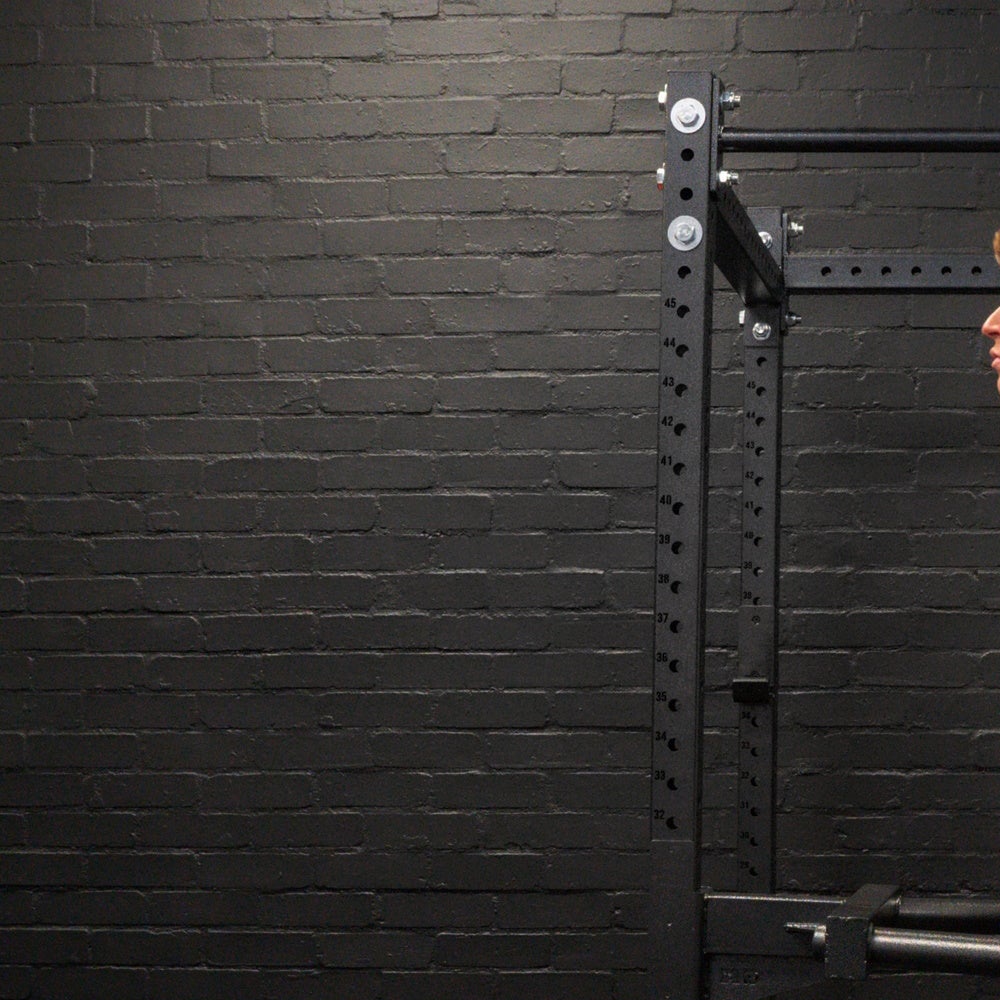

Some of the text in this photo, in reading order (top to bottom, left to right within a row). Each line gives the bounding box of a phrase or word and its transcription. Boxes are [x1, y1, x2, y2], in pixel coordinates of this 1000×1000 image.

[664, 298, 676, 308] 45
[663, 338, 676, 347] 44
[662, 377, 674, 387] 43
[747, 381, 756, 389] 45
[661, 416, 673, 426] 42
[661, 456, 672, 465] 41
[660, 495, 671, 504] 40
[659, 534, 670, 544] 39
[658, 574, 669, 584] 38
[657, 613, 668, 623] 37
[656, 652, 668, 662] 36
[656, 692, 667, 702] 35
[655, 731, 666, 741] 34
[654, 770, 665, 780] 33
[654, 809, 665, 819] 32
